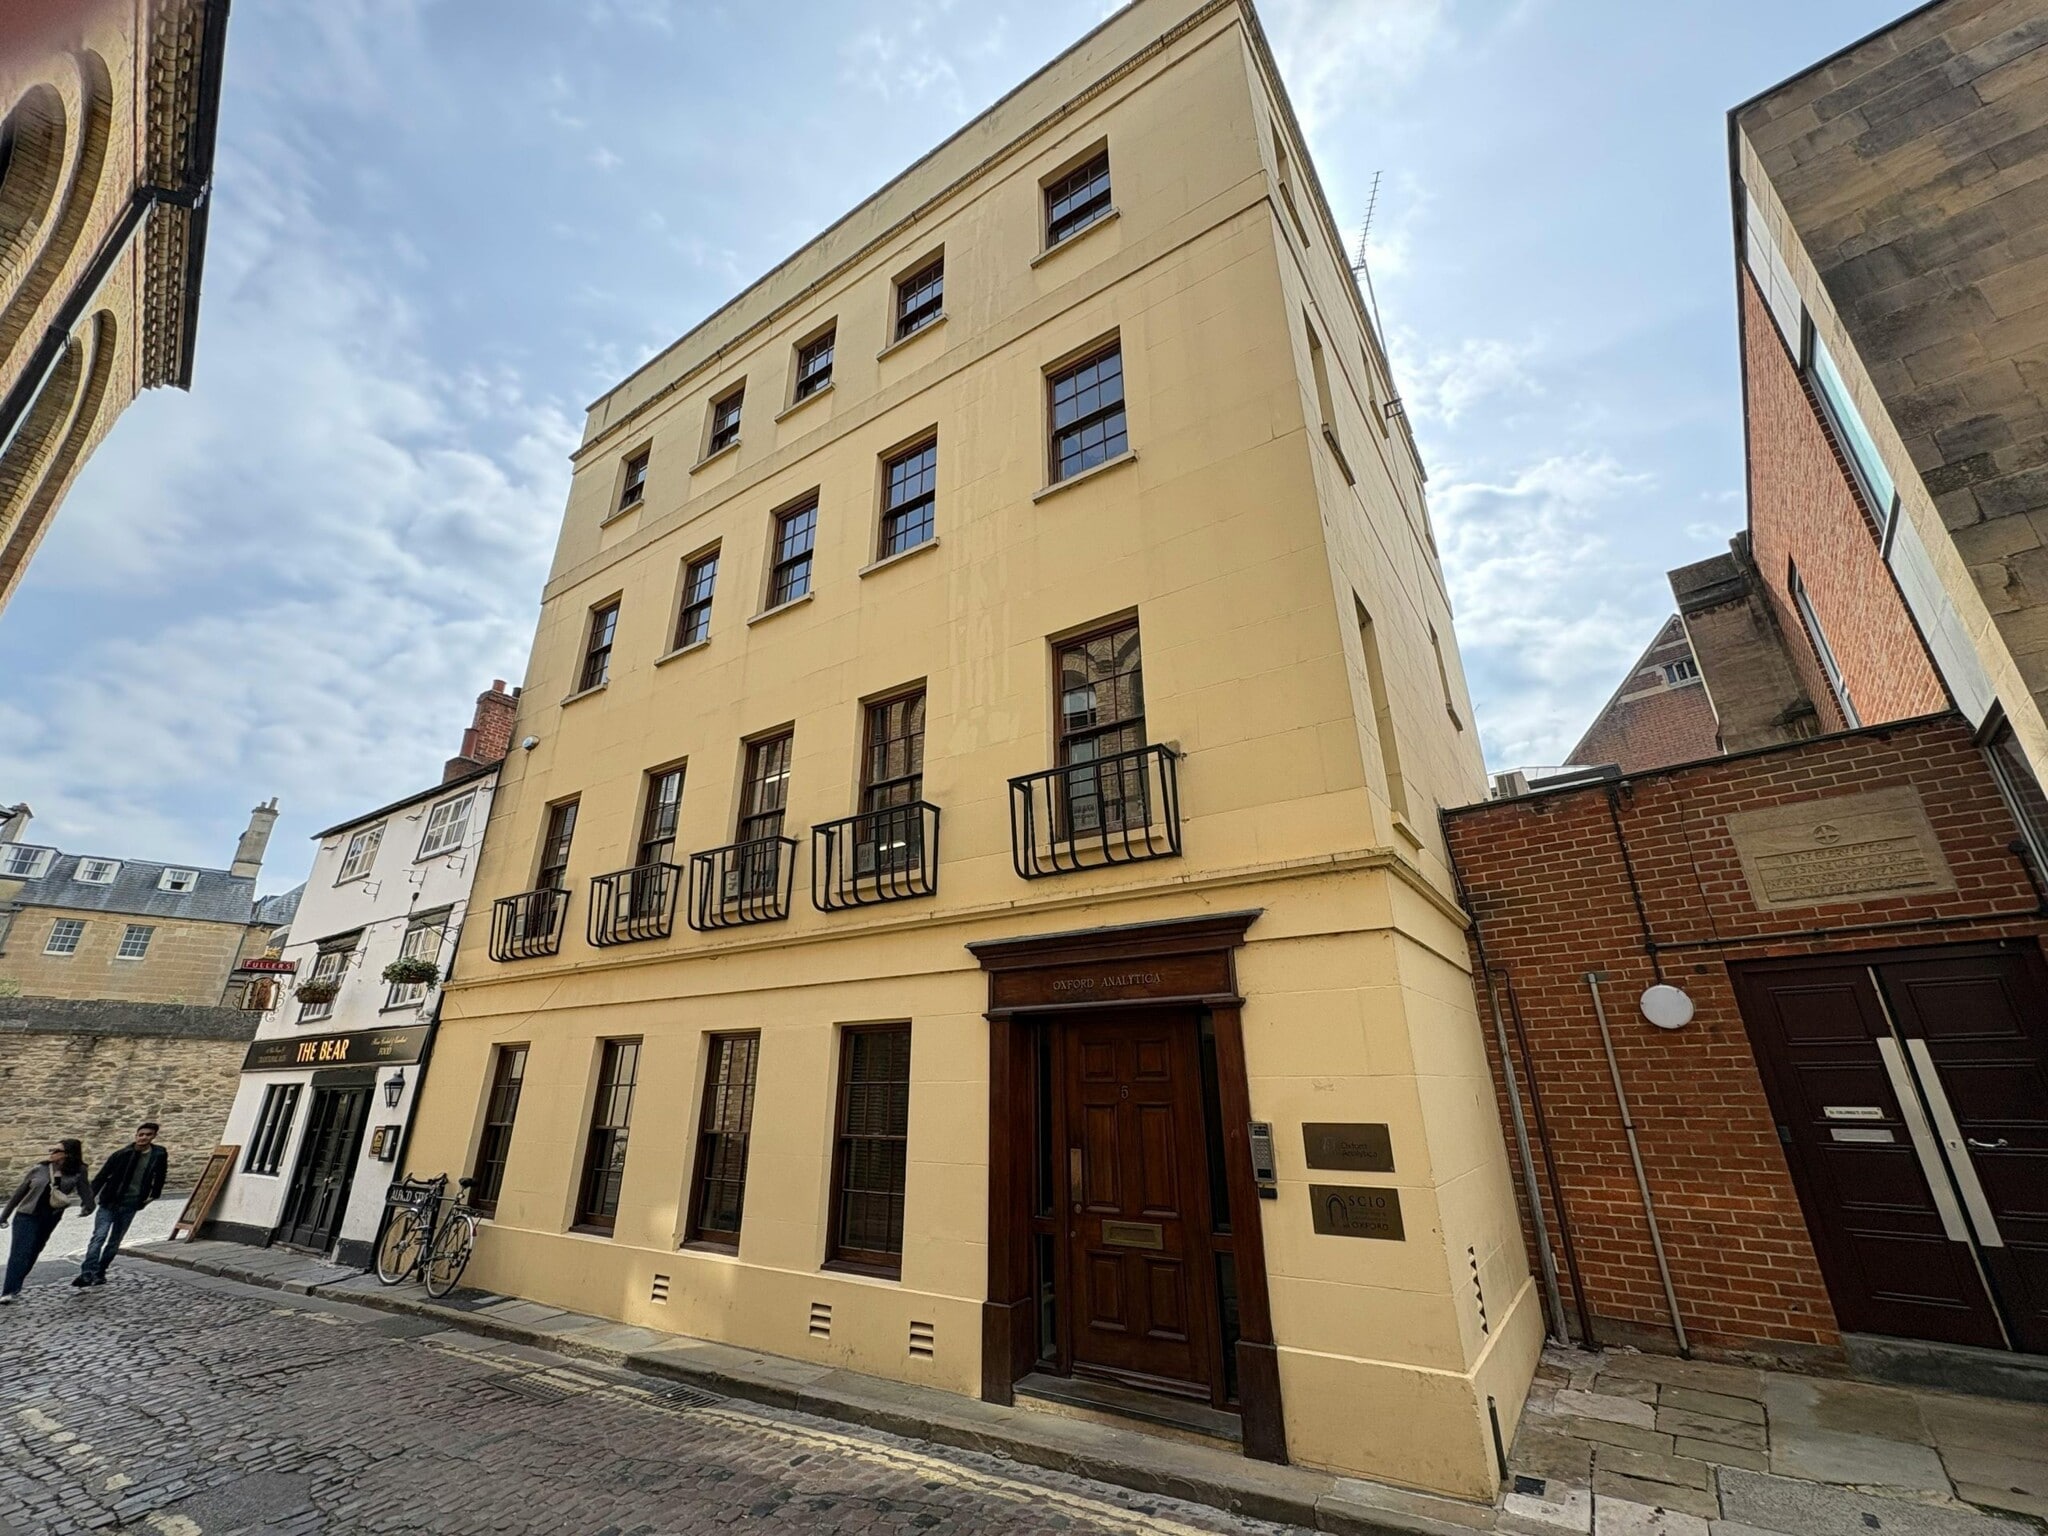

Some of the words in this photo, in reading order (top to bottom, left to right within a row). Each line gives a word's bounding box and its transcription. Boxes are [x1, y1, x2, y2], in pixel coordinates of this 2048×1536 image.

[1052, 978, 1095, 991] OXFORD
[1101, 972, 1161, 987] ANALYTICA
[296, 1042, 317, 1062] THE
[319, 1039, 349, 1061] BEAR
[1348, 1195, 1386, 1209] SCIO
